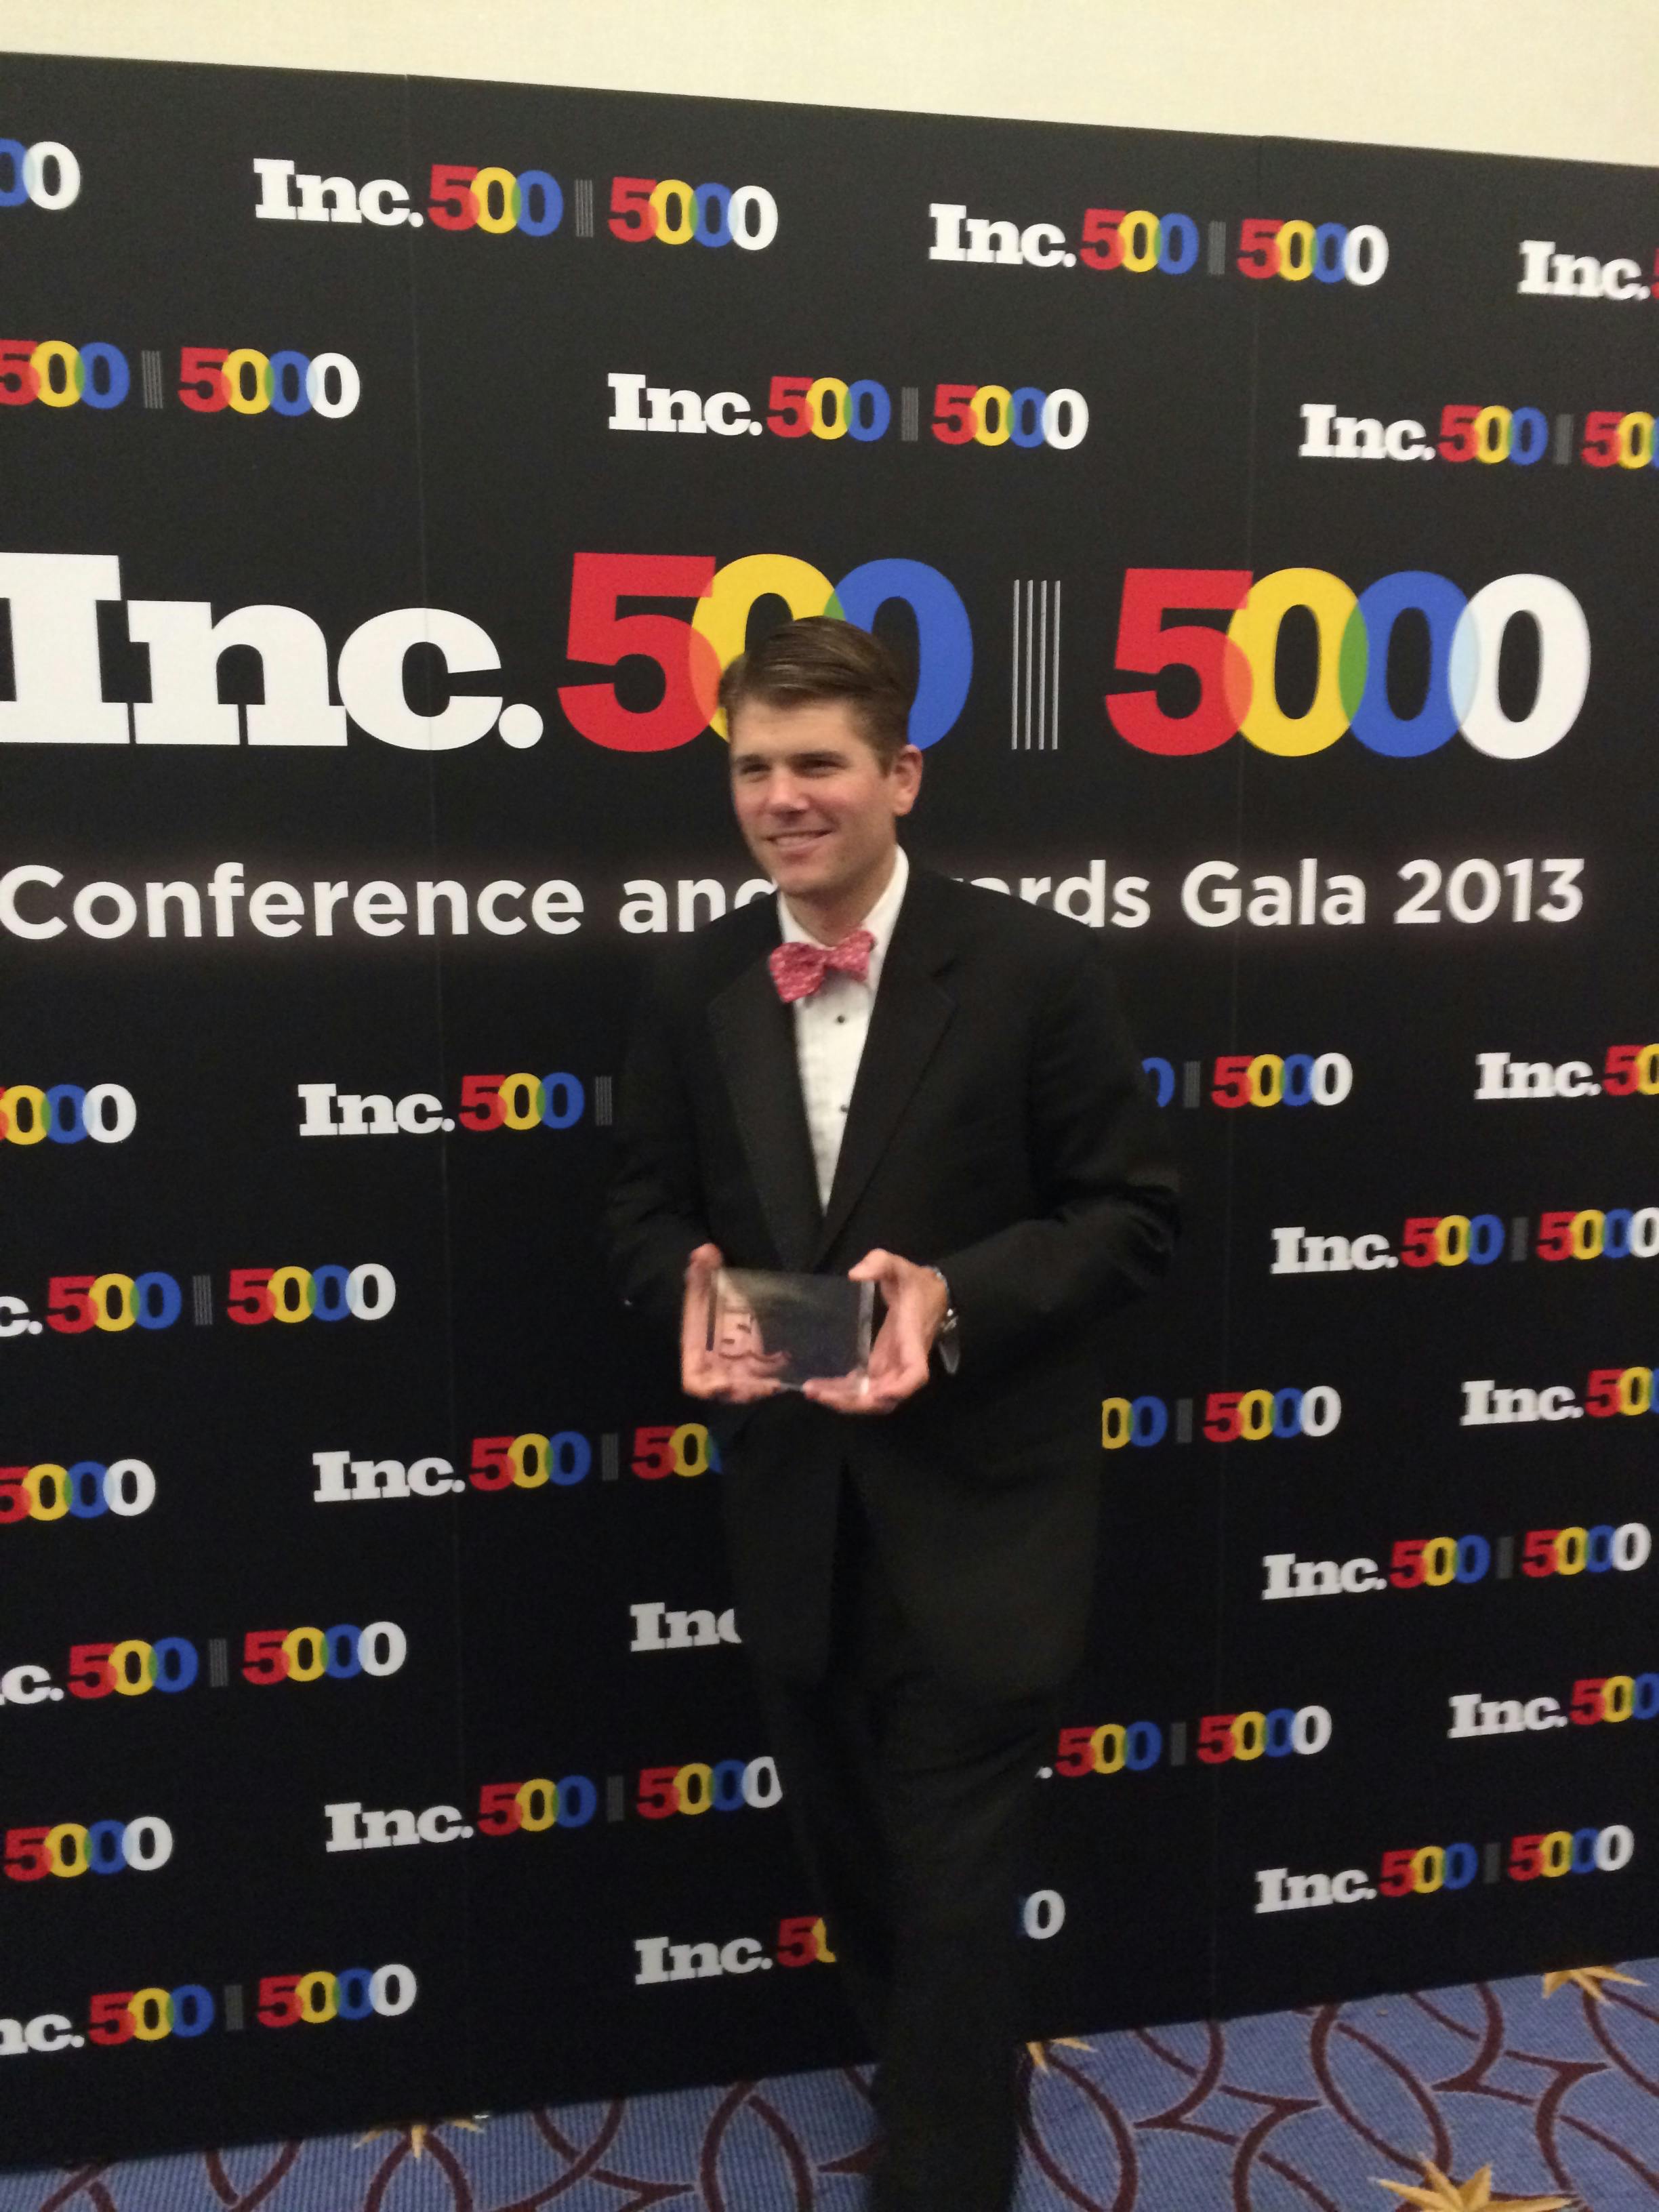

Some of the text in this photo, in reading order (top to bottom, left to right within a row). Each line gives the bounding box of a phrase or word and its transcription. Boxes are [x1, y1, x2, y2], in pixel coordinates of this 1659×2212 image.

[427, 164, 564, 237] 500
[607, 176, 778, 251] 5000
[1079, 208, 1199, 275] 500
[1236, 218, 1389, 287] 5000
[178, 347, 360, 419] 5000
[766, 375, 891, 442] 500
[931, 384, 1089, 450] 5000
[1437, 405, 1549, 466] 500
[1105, 567, 1591, 760] 5000
[0, 862, 584, 939] Conference
[1181, 859, 1366, 927] Gala
[1393, 859, 1584, 924] 2013
[459, 1073, 583, 1131] 500
[1212, 1052, 1353, 1108] 5000
[1401, 1214, 1504, 1267] 500
[47, 1272, 181, 1333] 500
[228, 1263, 396, 1324] 5000
[1102, 1386, 1341, 1449] 00 5000
[470, 1433, 590, 1490] 500
[1391, 1536, 1489, 1588] 500
[1523, 1523, 1651, 1577] 5000
[68, 1637, 197, 1698] 500
[243, 1622, 407, 1684] 5000
[1057, 1706, 1332, 1776] 500 5000
[479, 1777, 596, 1835] 500
[639, 1757, 782, 1818] 5000
[5, 1816, 173, 1881] 5000
[1380, 1843, 1476, 1896] 500
[1509, 1825, 1634, 1880] 5000
[89, 1986, 213, 2045] 500
[258, 1965, 417, 2026] 5000
